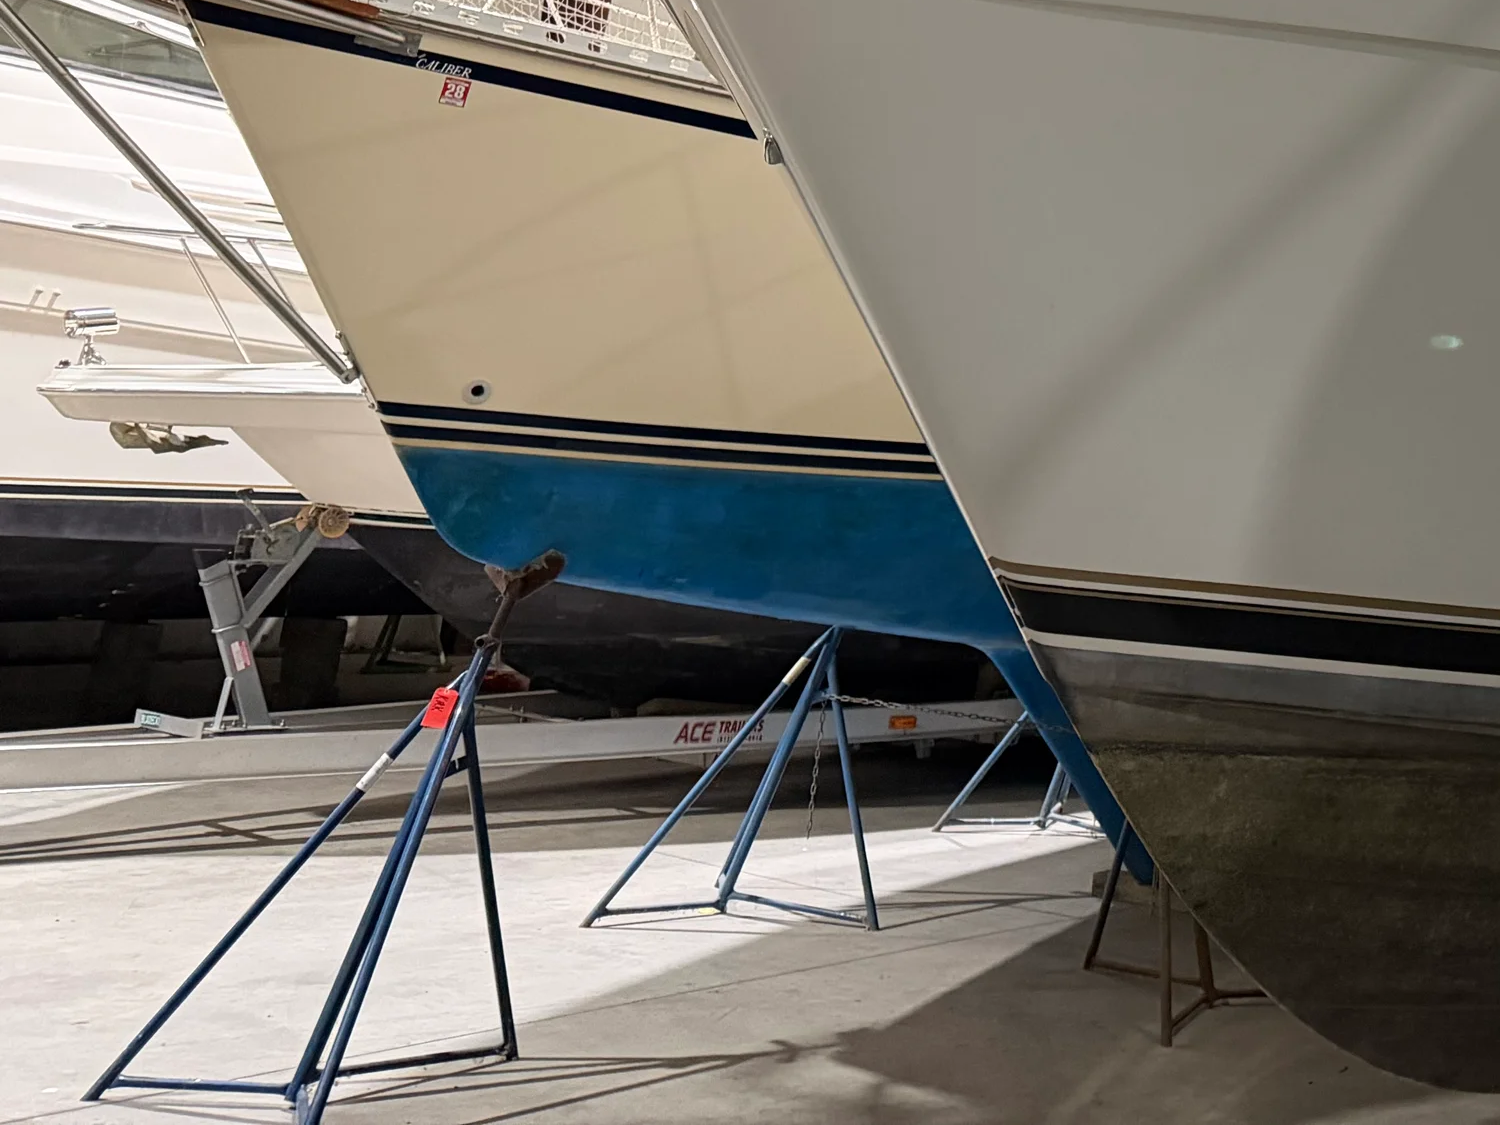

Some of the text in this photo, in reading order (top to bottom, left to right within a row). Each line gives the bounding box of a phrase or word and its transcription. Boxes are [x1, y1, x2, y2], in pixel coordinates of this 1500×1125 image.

[415, 58, 472, 79] CALIBER
[444, 82, 466, 100] 28
[673, 721, 716, 744] ACE
[719, 719, 765, 734] TRAIS
